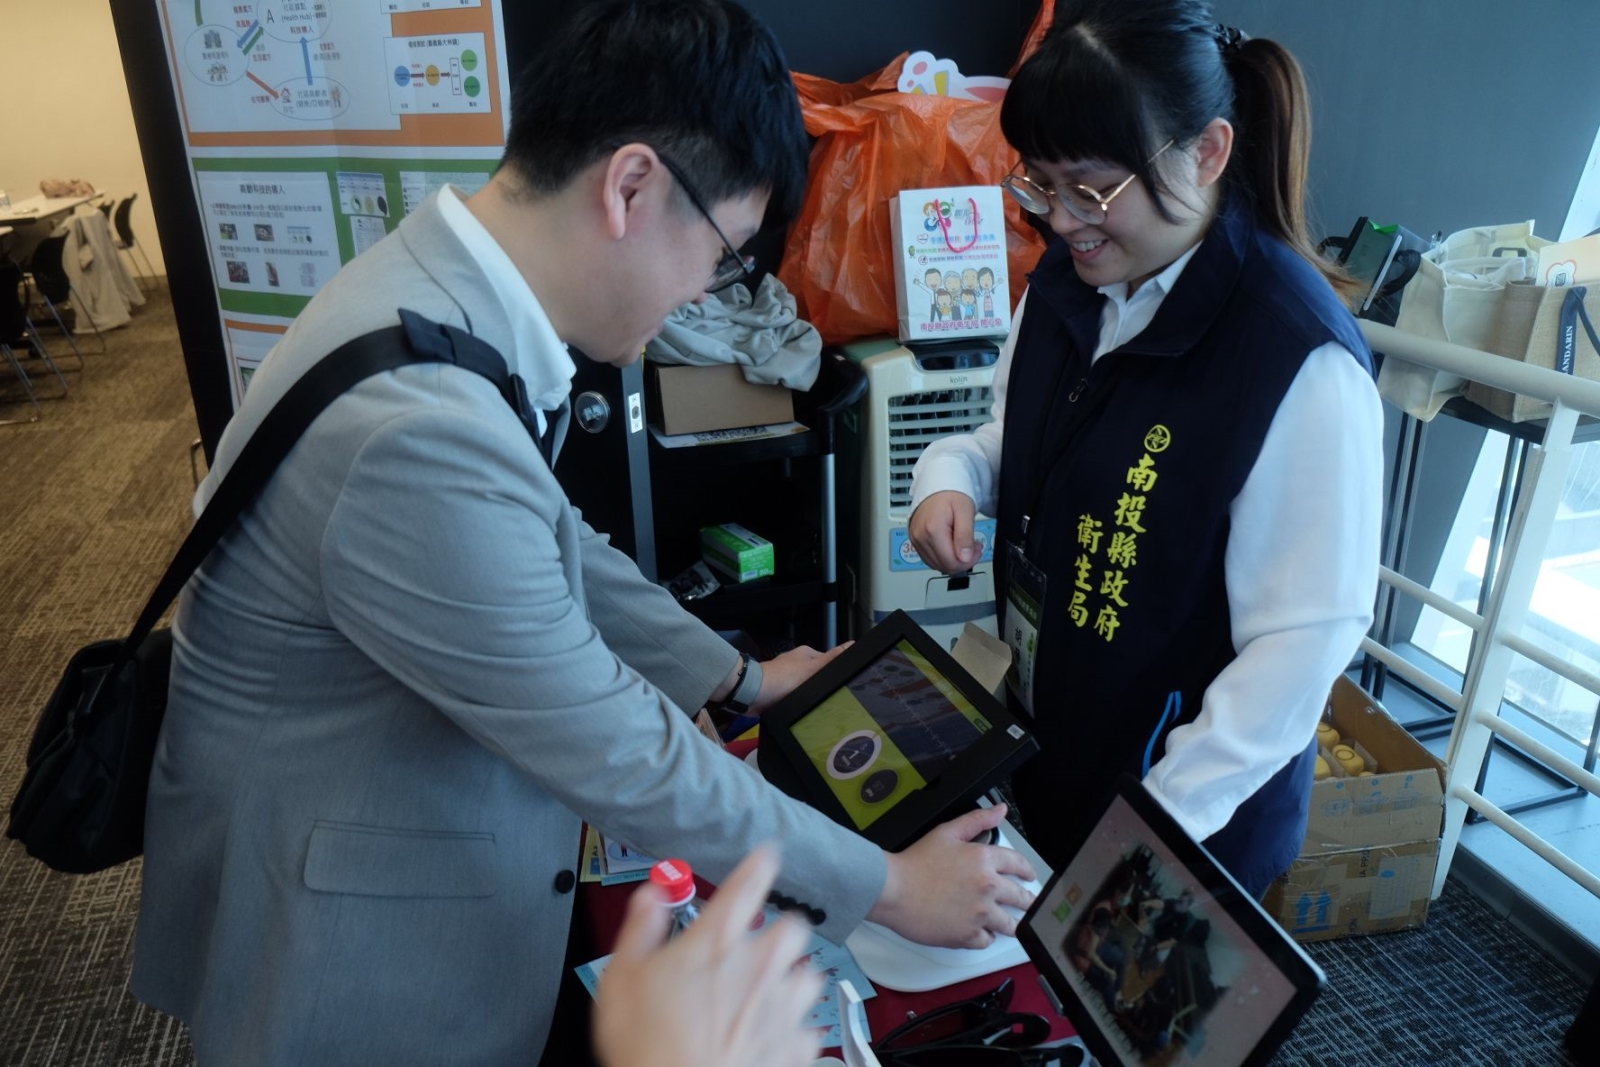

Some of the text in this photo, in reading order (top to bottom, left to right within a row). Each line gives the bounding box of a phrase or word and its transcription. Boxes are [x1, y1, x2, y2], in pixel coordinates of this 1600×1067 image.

[267, 9, 275, 24] A
[1562, 325, 1573, 374] ANDARIN
[949, 375, 968, 384] kolin
[1067, 513, 1104, 628] 衛生局
[1093, 452, 1159, 642] 南投縣政府
